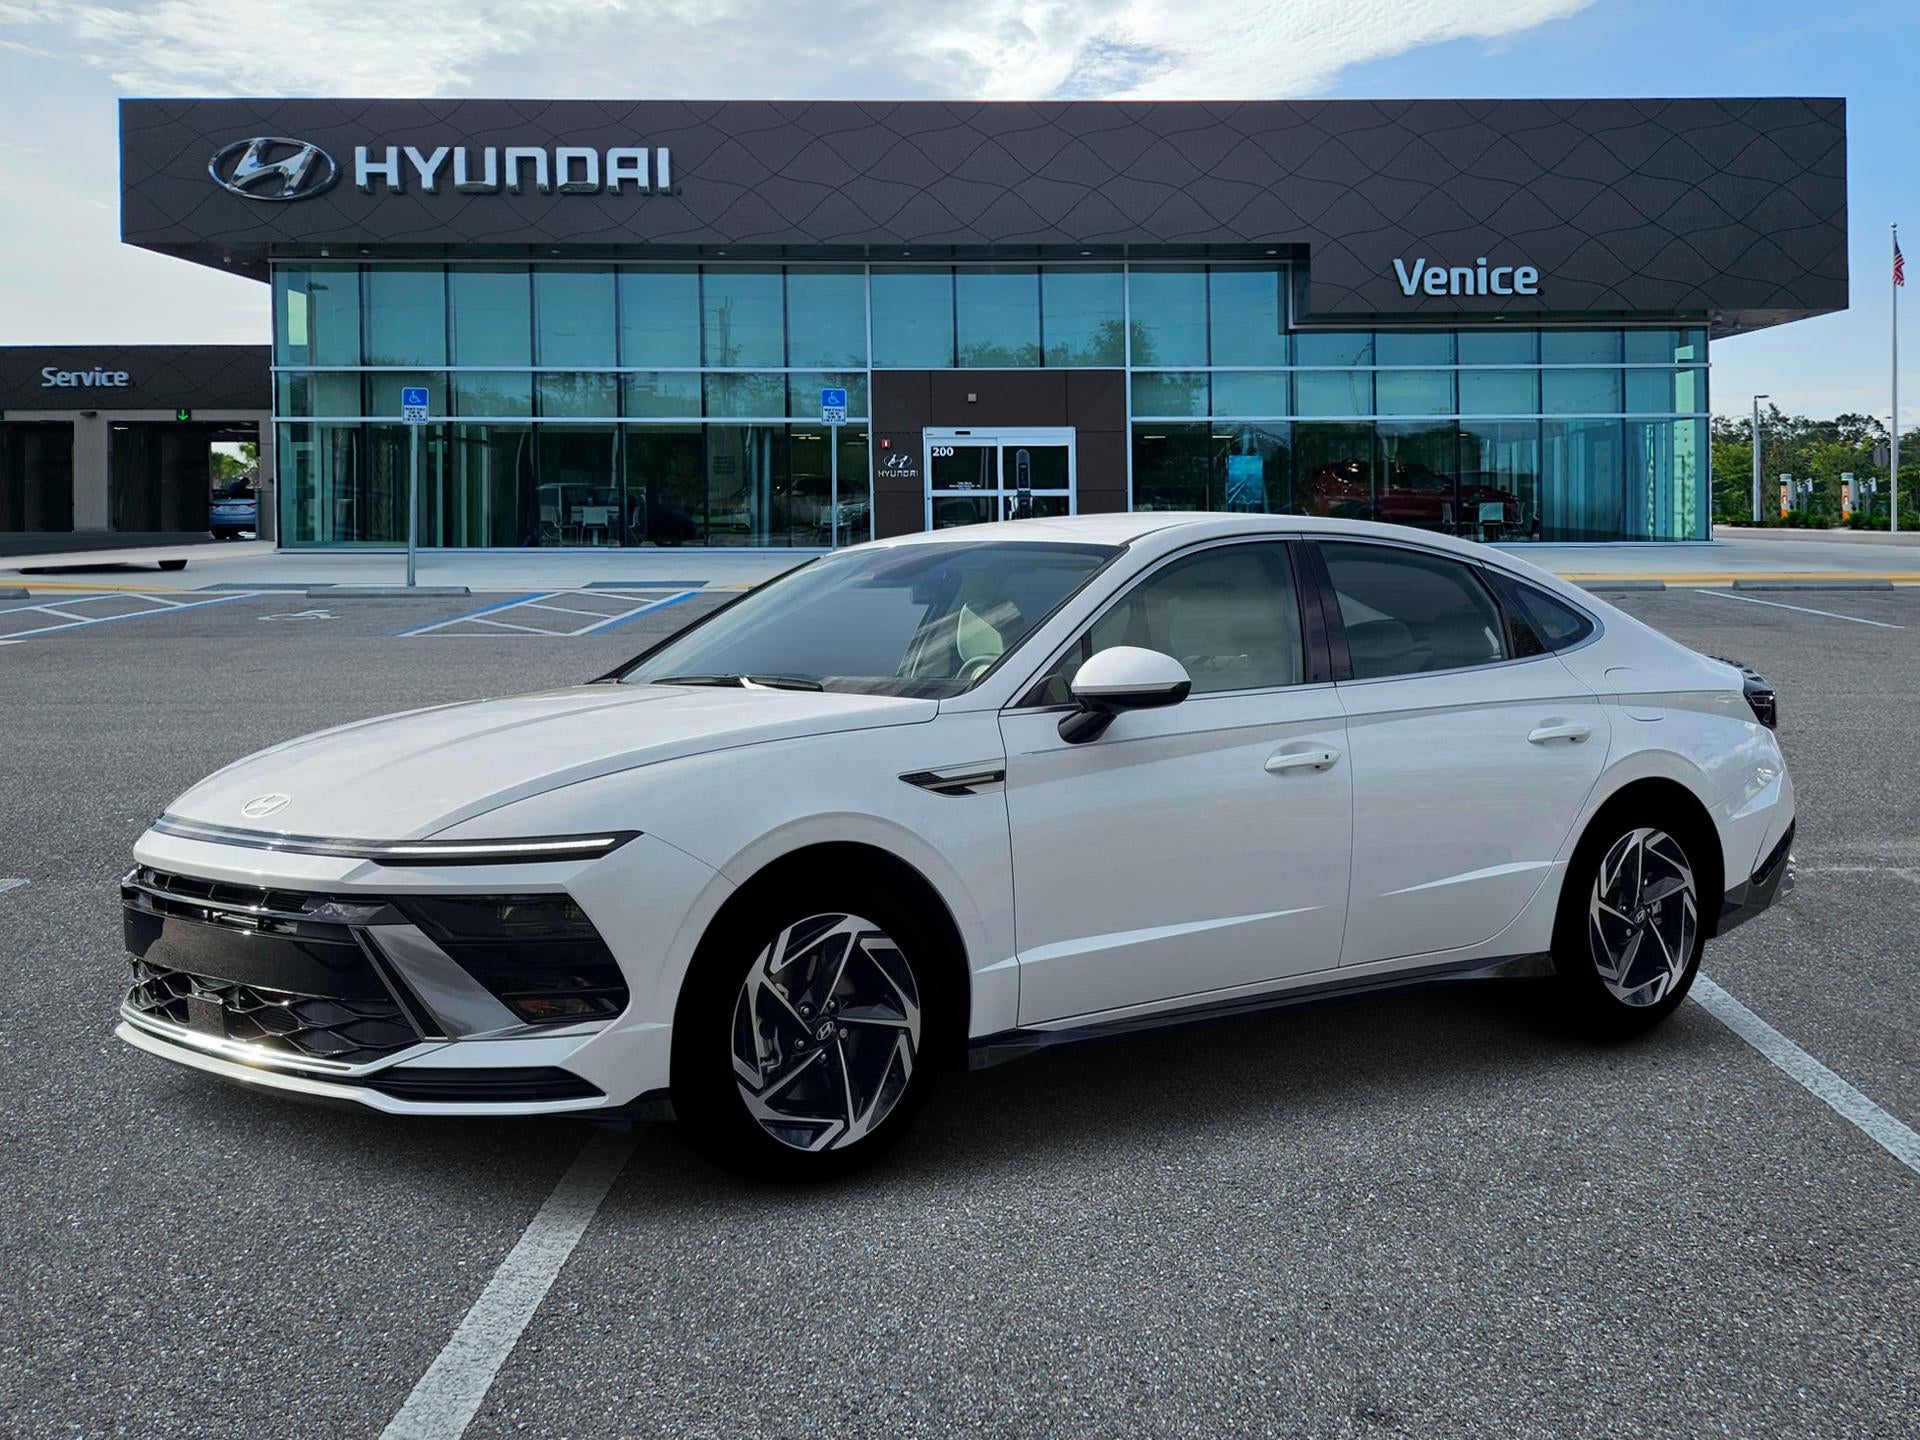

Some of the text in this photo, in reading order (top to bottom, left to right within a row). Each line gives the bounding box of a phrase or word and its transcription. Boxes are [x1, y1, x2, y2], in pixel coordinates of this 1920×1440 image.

[354, 146, 670, 194] HYUNDAI
[1392, 256, 1539, 296] Venice
[41, 366, 129, 387] Service
[932, 446, 954, 457] 200
[878, 469, 919, 478] HYUNDAI
